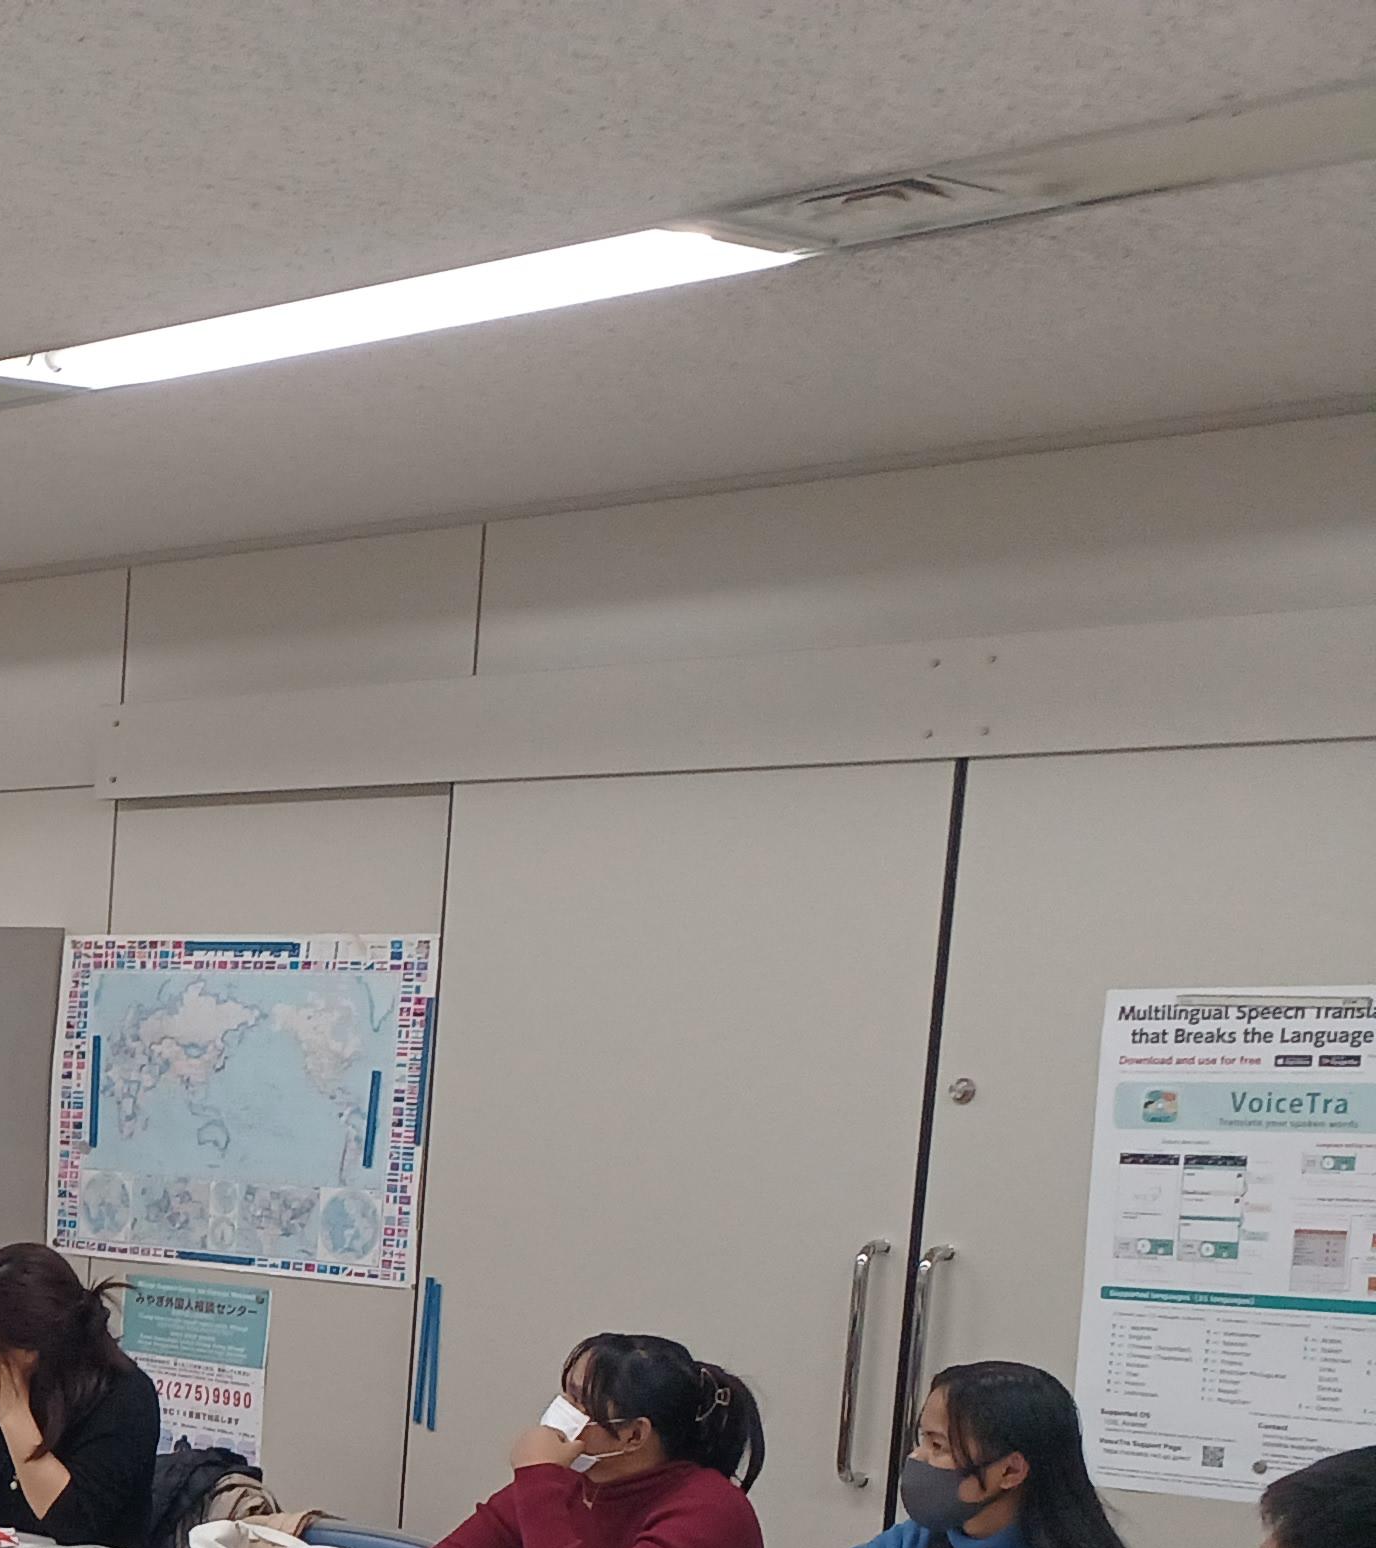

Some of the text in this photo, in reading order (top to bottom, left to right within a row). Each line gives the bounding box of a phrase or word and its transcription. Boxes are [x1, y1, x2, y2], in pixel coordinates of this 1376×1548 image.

[1117, 1003, 1230, 1025] Multilingual
[1236, 1005, 1306, 1025] Speech
[1131, 1027, 1375, 1048] that Breaks the Language
[1118, 1055, 1262, 1066] Download and use for free
[1230, 1091, 1349, 1114] VoiceTra
